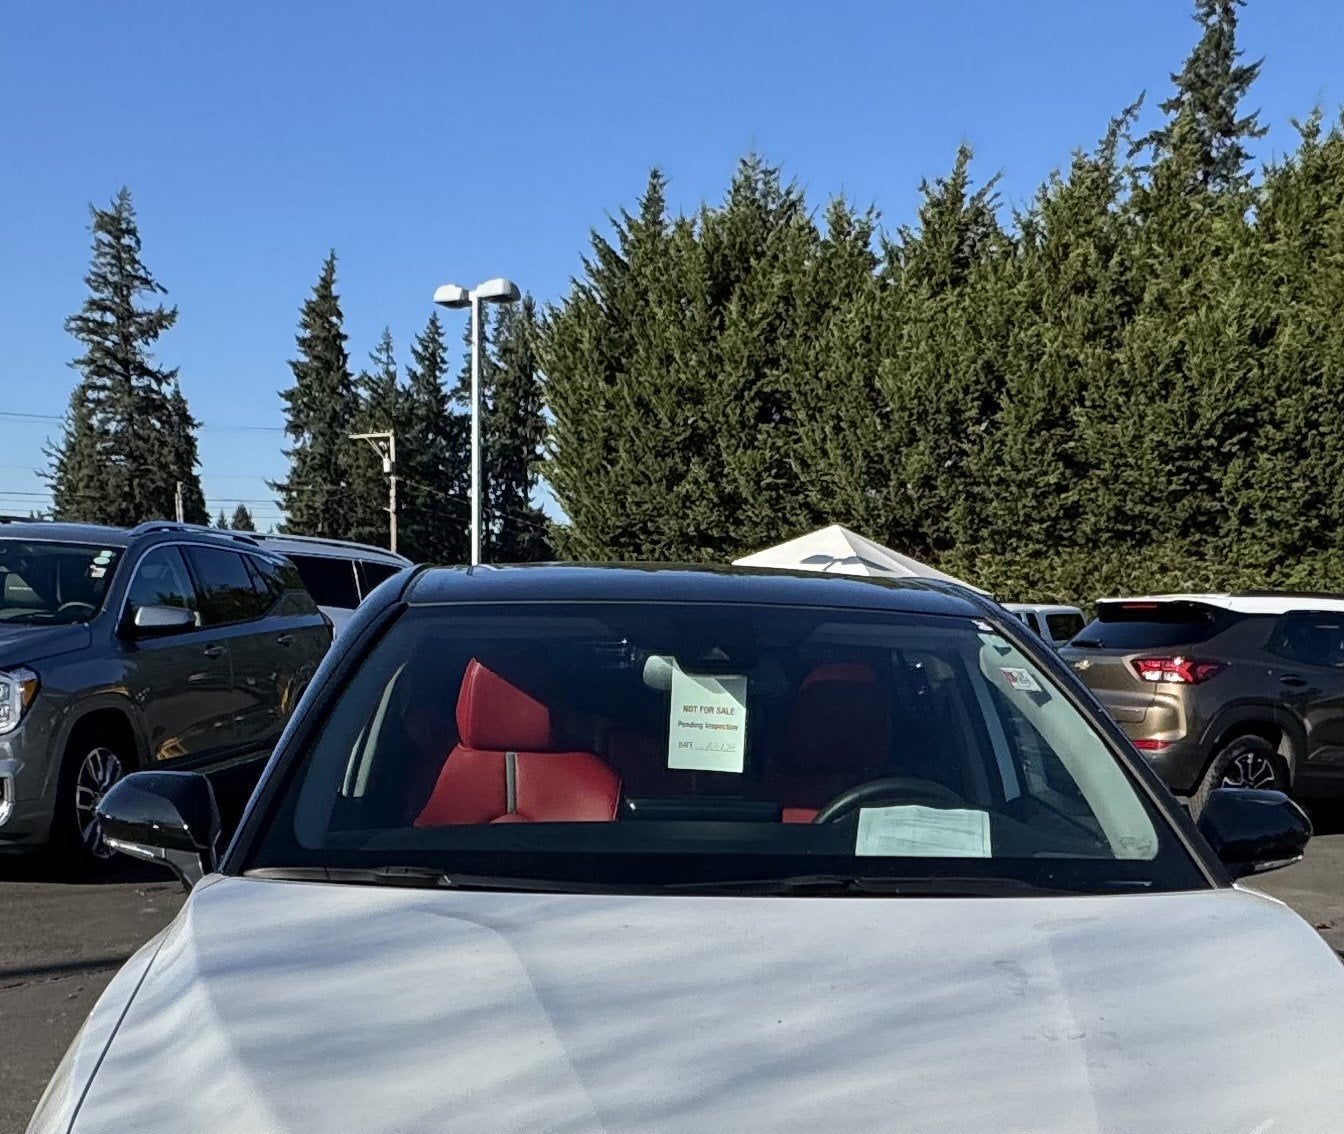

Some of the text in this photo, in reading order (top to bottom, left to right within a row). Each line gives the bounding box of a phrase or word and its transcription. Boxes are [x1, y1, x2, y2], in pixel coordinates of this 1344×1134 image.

[682, 705, 735, 715] NOT FOR SALE
[677, 720, 703, 730] Pending
